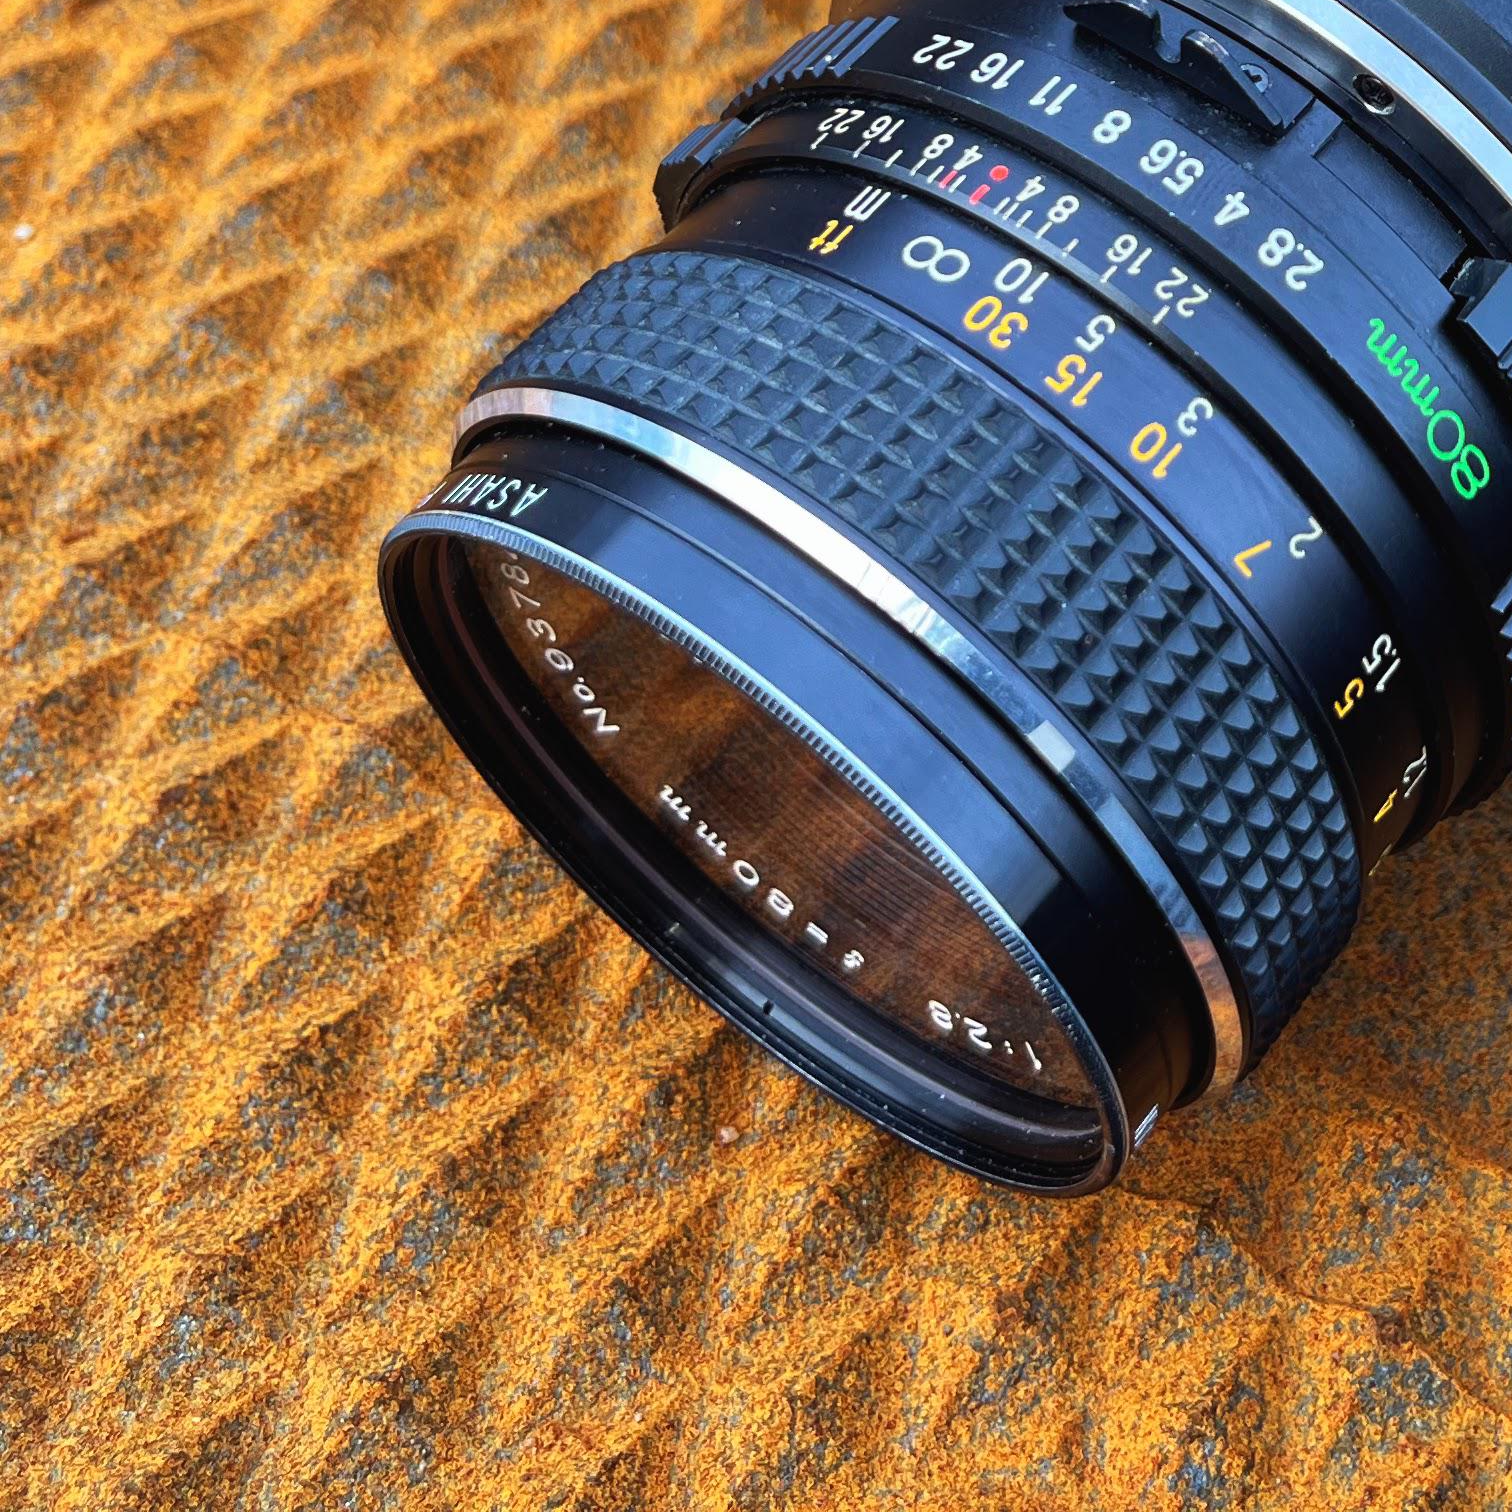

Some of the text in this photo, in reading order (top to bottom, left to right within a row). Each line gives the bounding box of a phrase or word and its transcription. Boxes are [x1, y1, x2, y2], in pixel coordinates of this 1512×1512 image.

[912, 34, 1324, 291] 2.8 4 5.6 8 11 16 22
[817, 108, 1209, 317] 22 16 8 4 4 8 16 22
[843, 186, 891, 222] m
[809, 220, 853, 254] ft
[994, 257, 1050, 304] 10
[963, 296, 1029, 348] 30
[1075, 314, 1116, 353] 5
[1044, 353, 1103, 407] 15
[1177, 397, 1213, 436] 3
[1366, 317, 1490, 499] 80mm
[1129, 421, 1183, 479] 10
[442, 474, 548, 517] ASAHI
[1234, 540, 1272, 578] 7
[1289, 515, 1323, 559] 2
[1362, 633, 1401, 692] 1.5
[1334, 677, 1364, 719] 5
